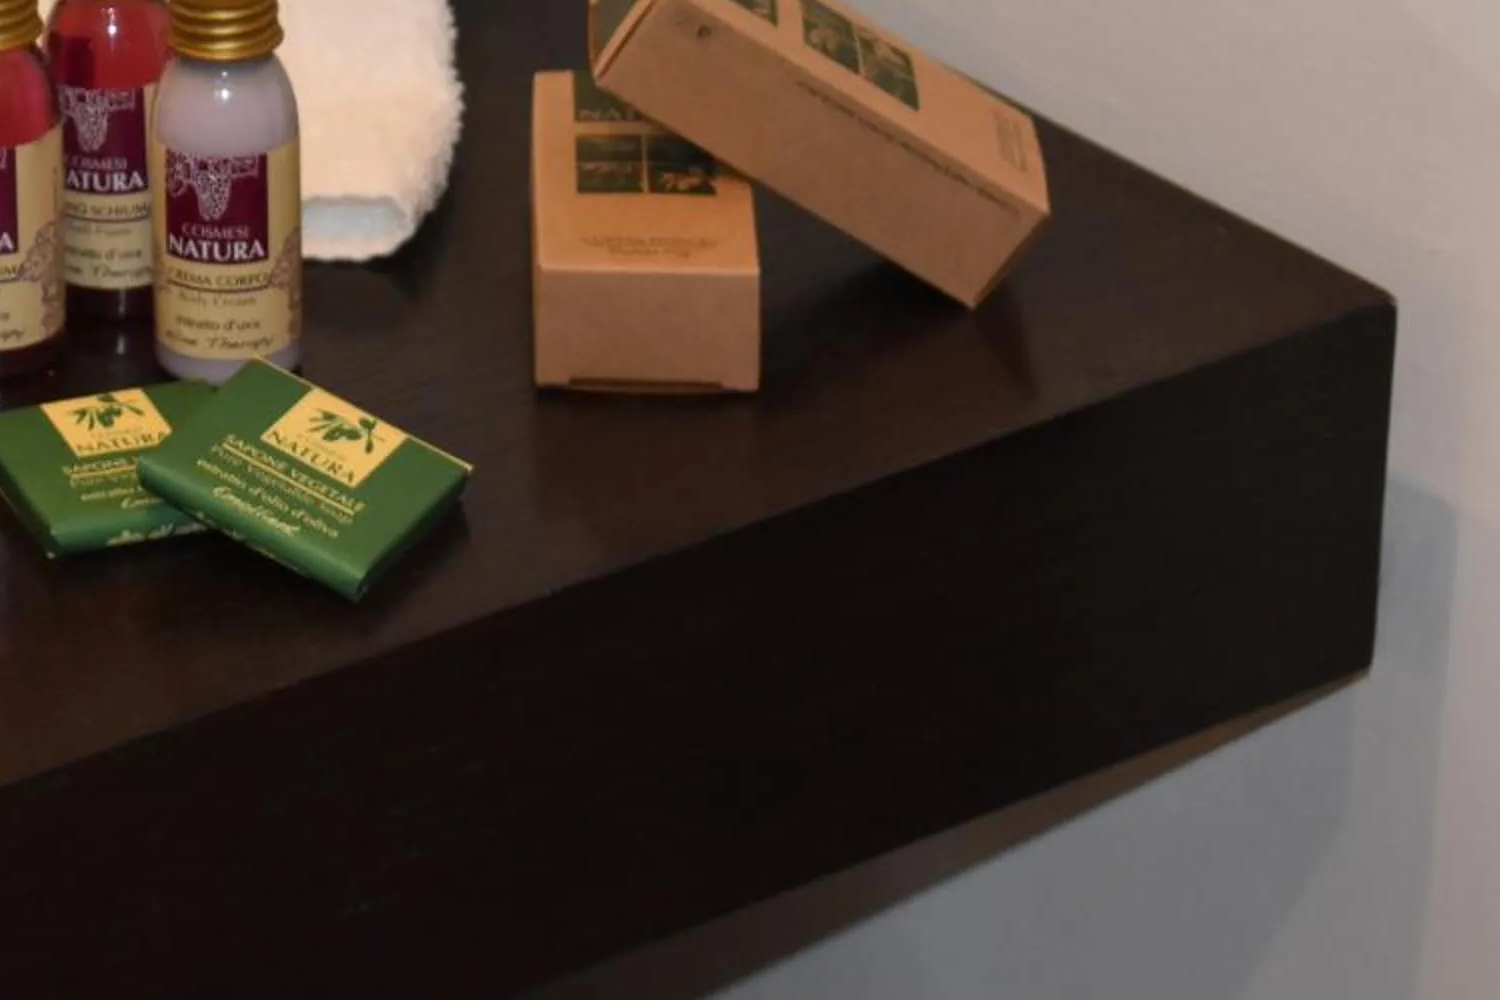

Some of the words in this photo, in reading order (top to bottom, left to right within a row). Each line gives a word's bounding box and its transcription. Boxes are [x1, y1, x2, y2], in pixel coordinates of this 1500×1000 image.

[67, 168, 145, 192] ATURA
[181, 222, 250, 239] COSMESI
[169, 231, 266, 261] NATURA
[75, 430, 168, 450] NATURA
[270, 428, 357, 484] NATURA
